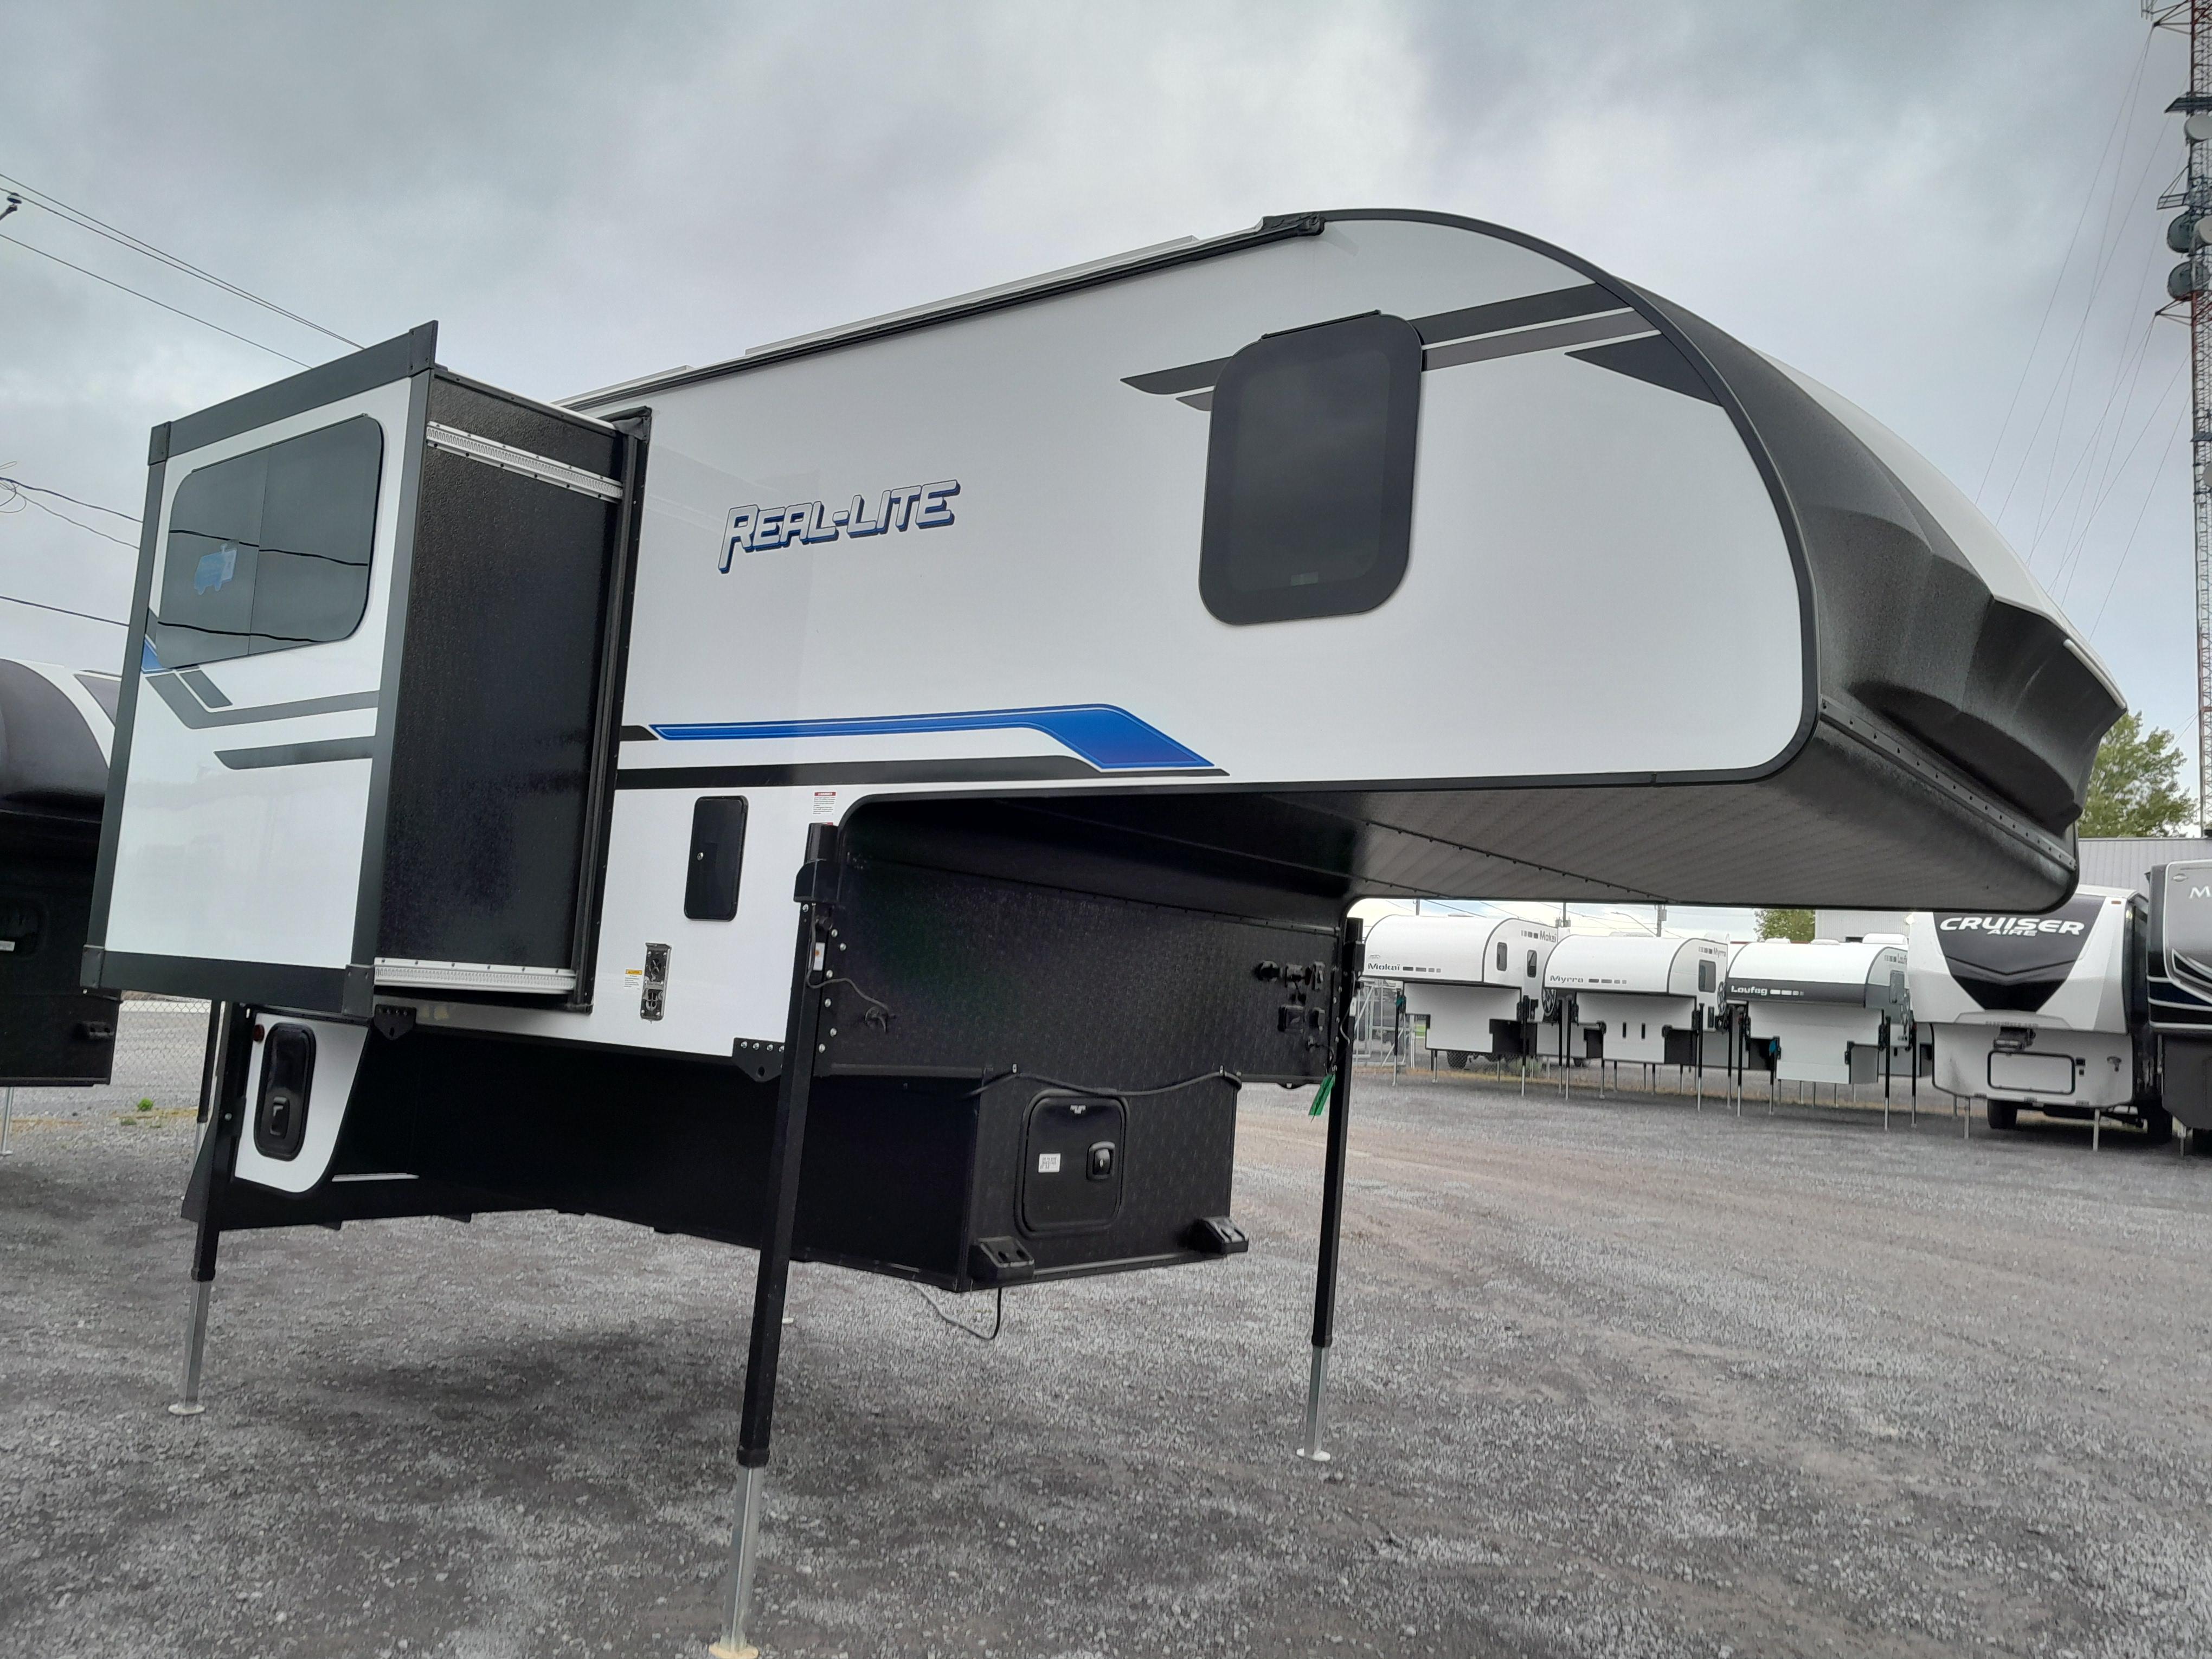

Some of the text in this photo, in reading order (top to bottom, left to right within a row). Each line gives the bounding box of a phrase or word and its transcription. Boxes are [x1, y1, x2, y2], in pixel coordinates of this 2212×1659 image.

[718, 479, 961, 574] REAL-LITE
[1940, 917, 2085, 935] CRUISER
[1550, 975, 1583, 983] Myrra
